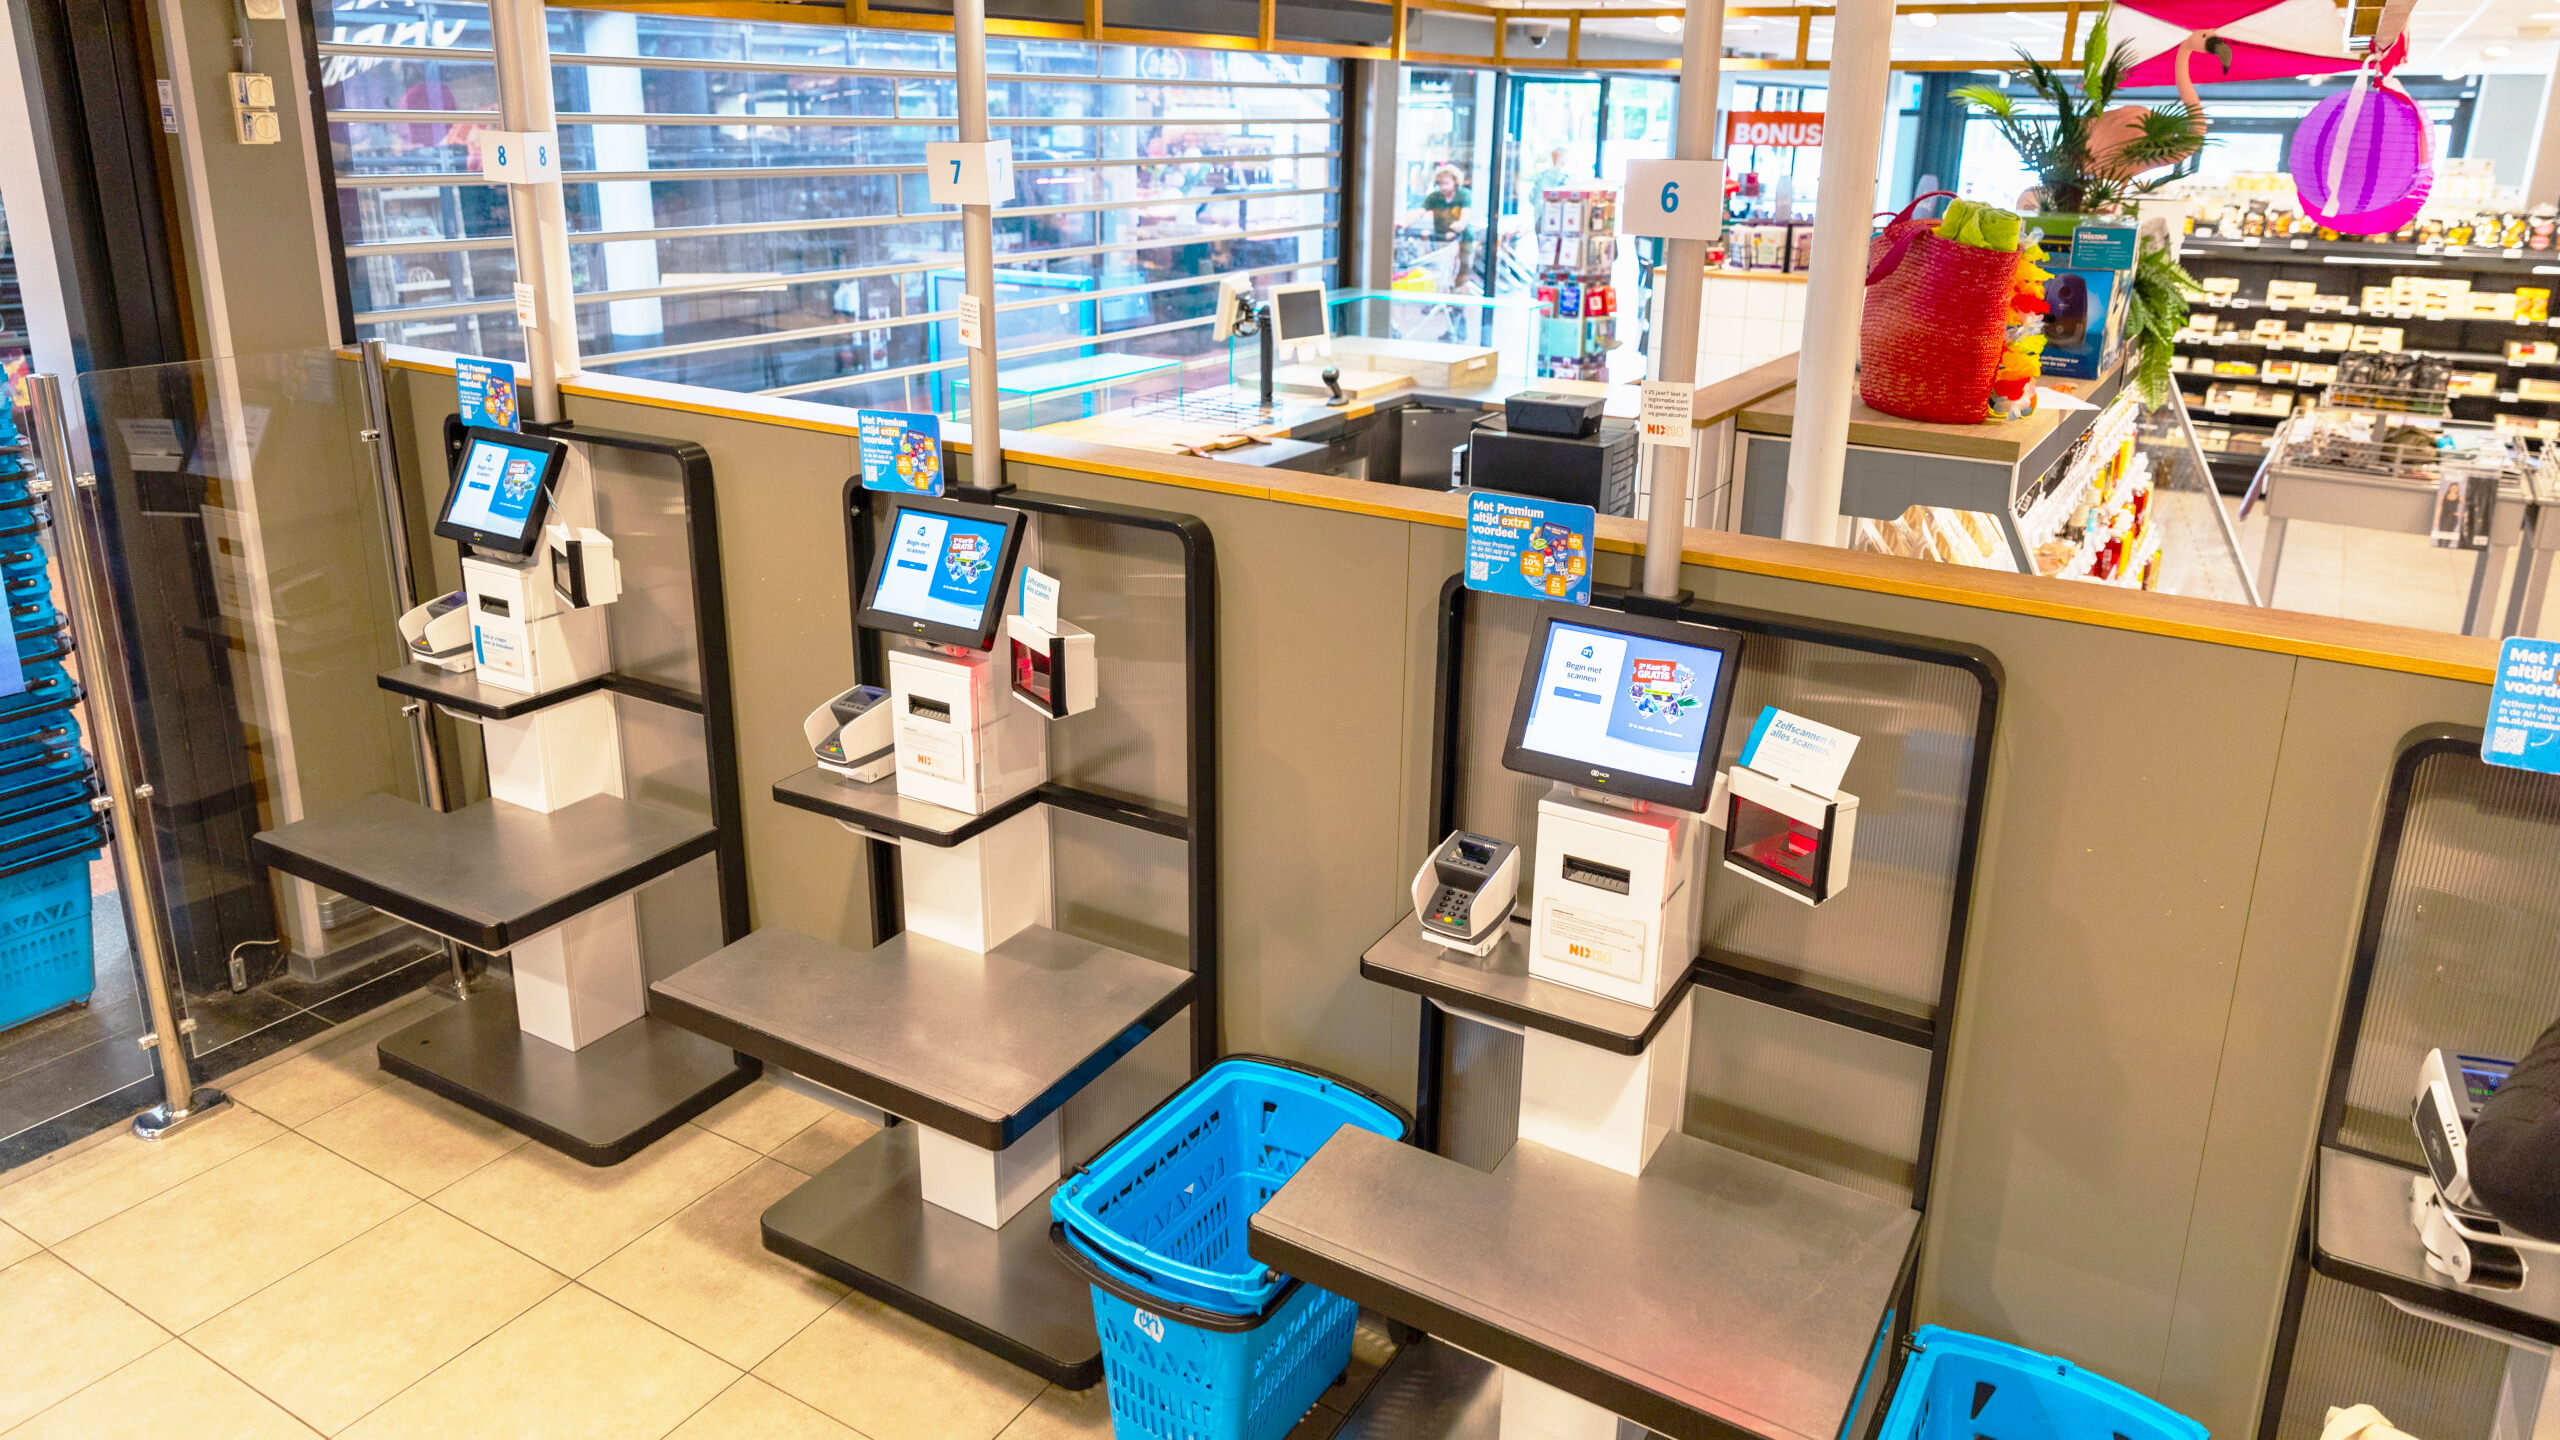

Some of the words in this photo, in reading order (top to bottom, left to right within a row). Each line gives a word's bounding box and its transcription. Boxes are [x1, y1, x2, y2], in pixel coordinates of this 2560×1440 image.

[1734, 122, 1823, 145] BONUS
[497, 145, 507, 167] 8
[538, 145, 547, 168] 8
[949, 160, 962, 185] 7
[996, 158, 1003, 182] 7
[1660, 181, 1680, 214] 6
[861, 416, 875, 425] Met
[876, 416, 908, 427] Premium
[862, 426, 879, 436] altijd
[880, 427, 900, 437] extra
[862, 436, 894, 446] voordeel.
[1473, 500, 1494, 512] Met
[1497, 503, 1544, 519] Premium
[1473, 512, 1499, 527] altijd
[1501, 517, 1530, 529] extra
[1472, 525, 1519, 540] voordeel.
[2509, 647, 2547, 666] Met
[1566, 661, 1586, 671] Begin
[1587, 666, 1602, 674] met
[1637, 670, 1671, 680] GRATIS
[2506, 664, 2555, 683] altijd
[1566, 672, 1597, 683] scannen
[2501, 698, 2536, 710] Activeer
[2499, 707, 2508, 715] in
[2509, 708, 2521, 717] de
[2522, 710, 2536, 719] AH
[2538, 712, 2555, 722] app
[1775, 720, 1827, 744] Zelfscannen
[1770, 729, 1790, 743] alles
[1792, 737, 1830, 757] scannen.
